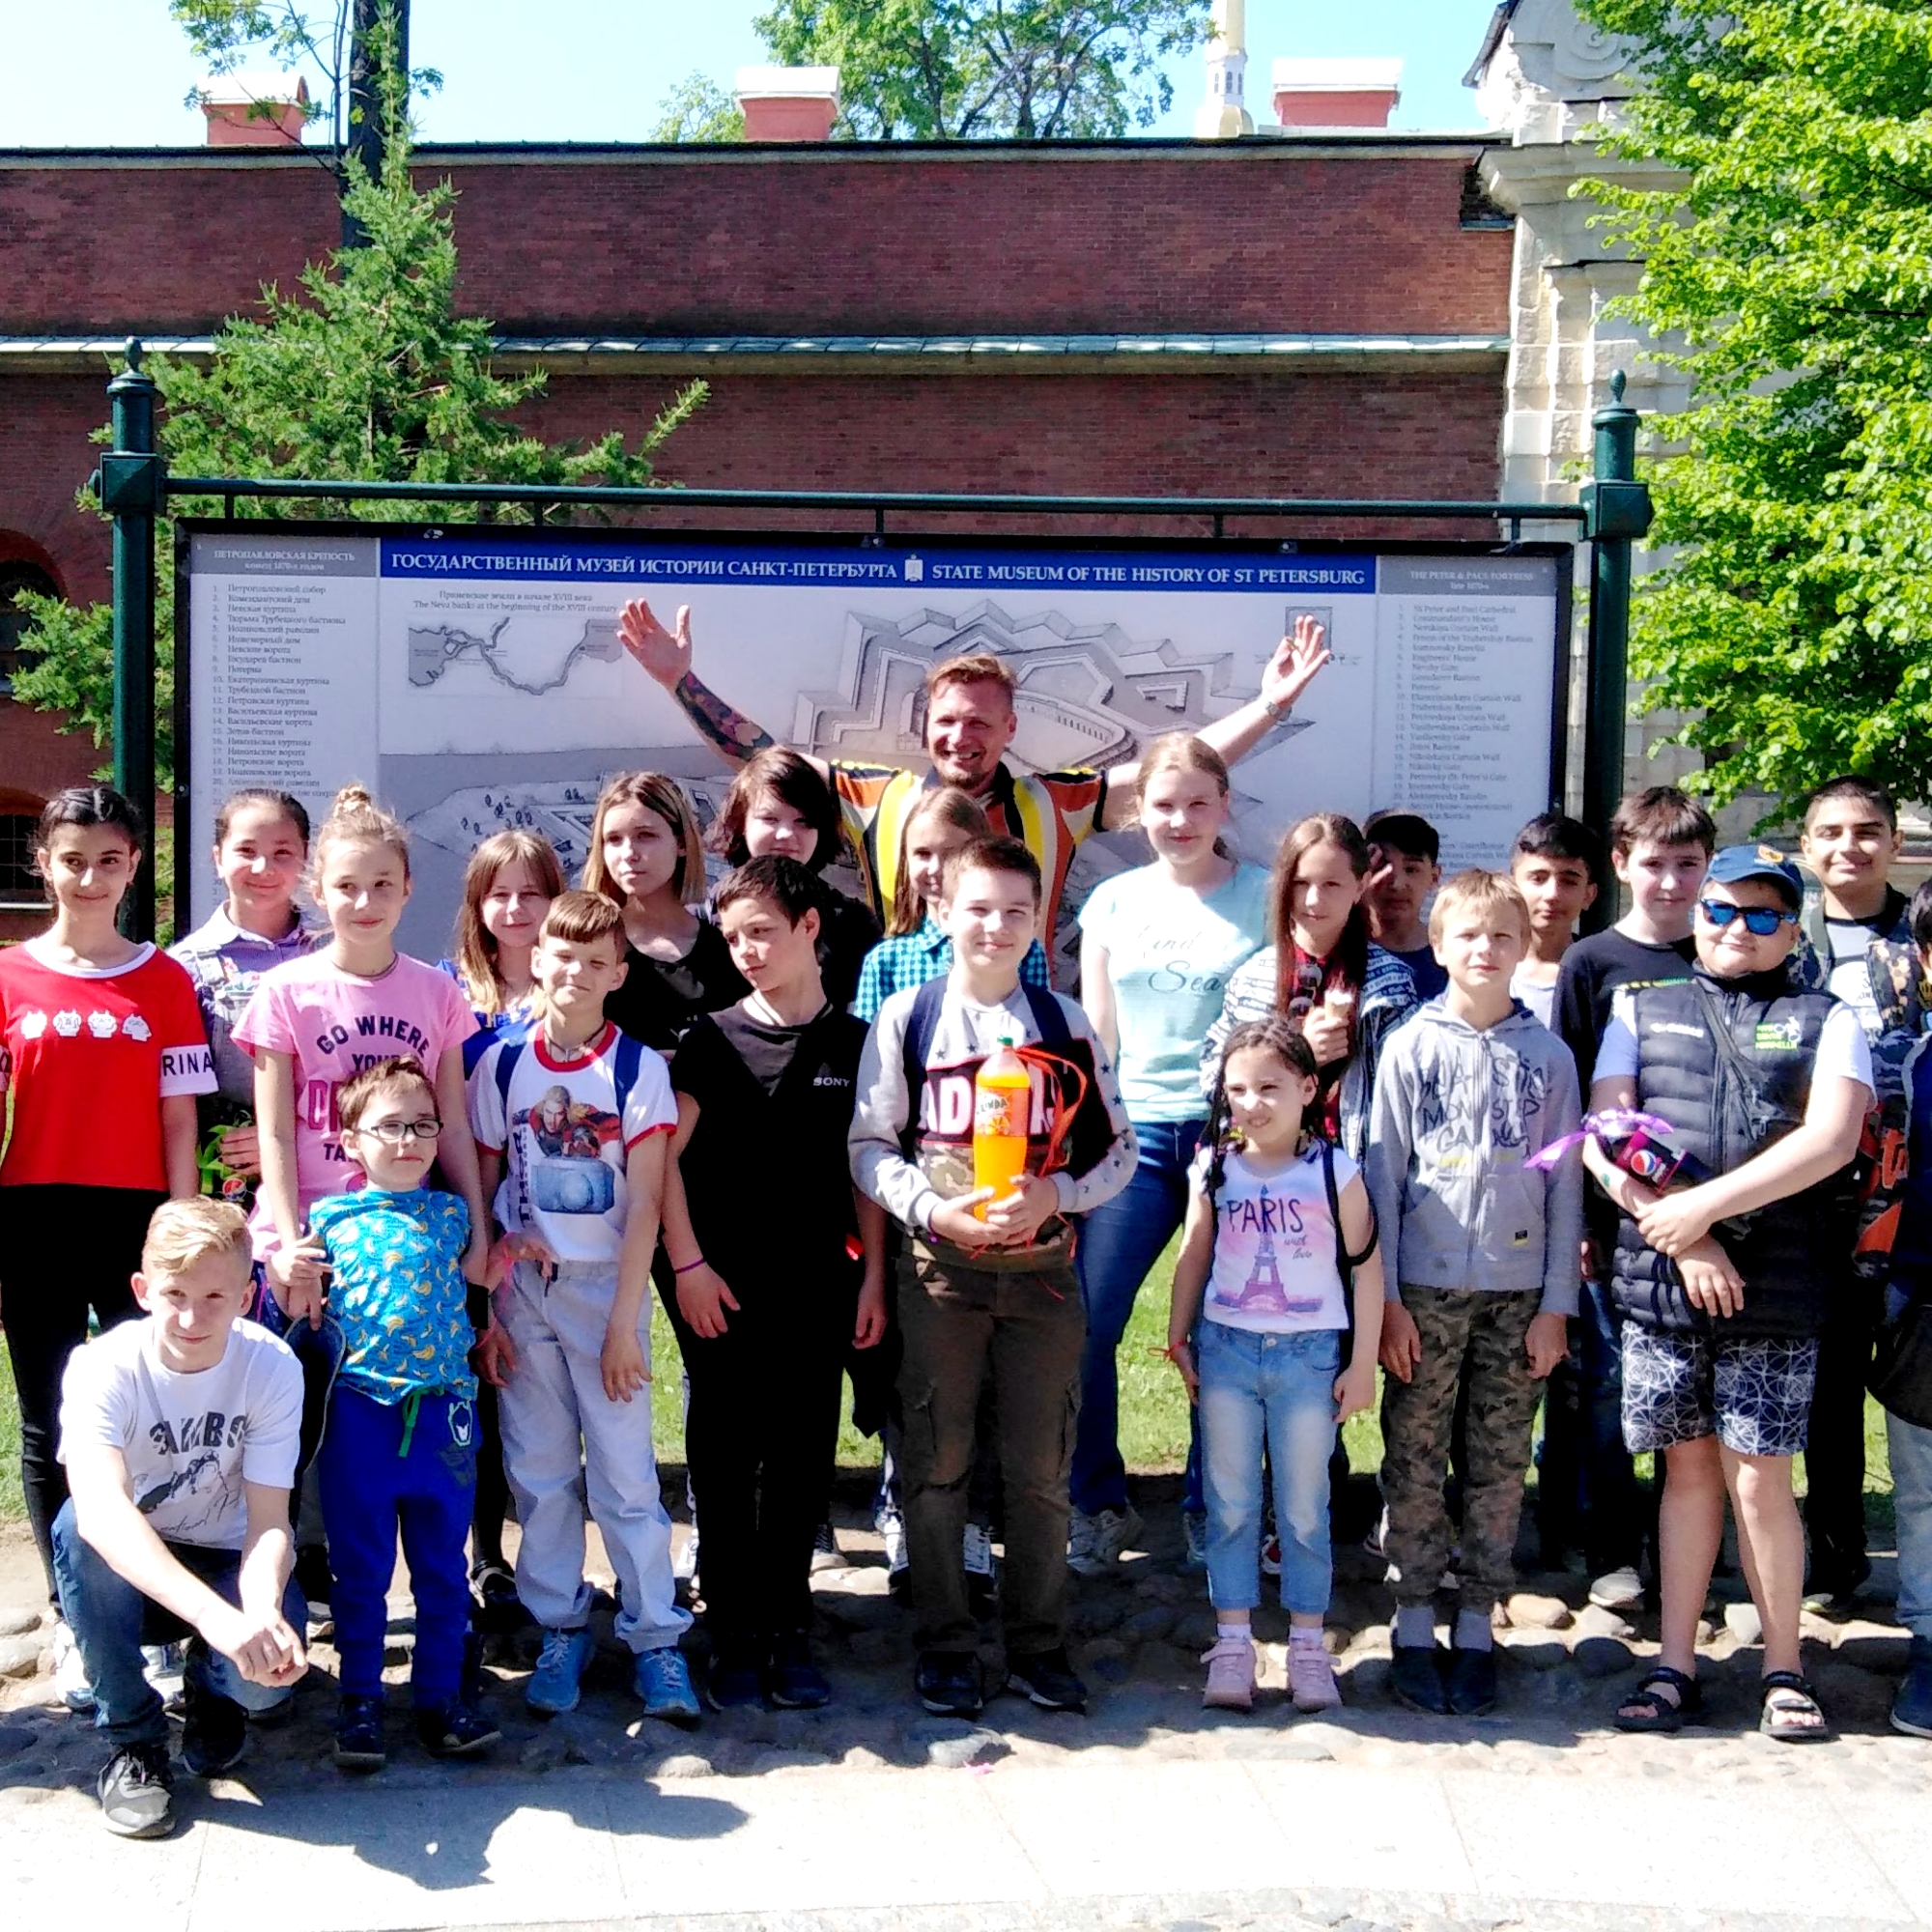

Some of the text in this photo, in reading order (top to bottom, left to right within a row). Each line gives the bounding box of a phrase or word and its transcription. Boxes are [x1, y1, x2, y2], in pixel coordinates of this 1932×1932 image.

[307, 552, 355, 561] КРЕПОСТЬ
[391, 554, 897, 578] ГОСУДАРСТВЕННЫЙ МУЗЕЙ ИСТОРИИ САНКТ-ПЕТЕРБУРГА
[932, 564, 1365, 585] STATE MUSEUM OF THE HISTORY OF ST PETERSBURG
[413, 600, 430, 609] The
[500, 602, 541, 611] beginning
[316, 1015, 431, 1059] GO WHERE
[162, 1051, 214, 1078] RINA
[812, 1076, 850, 1088] SONY
[1226, 1198, 1304, 1234] PARIS
